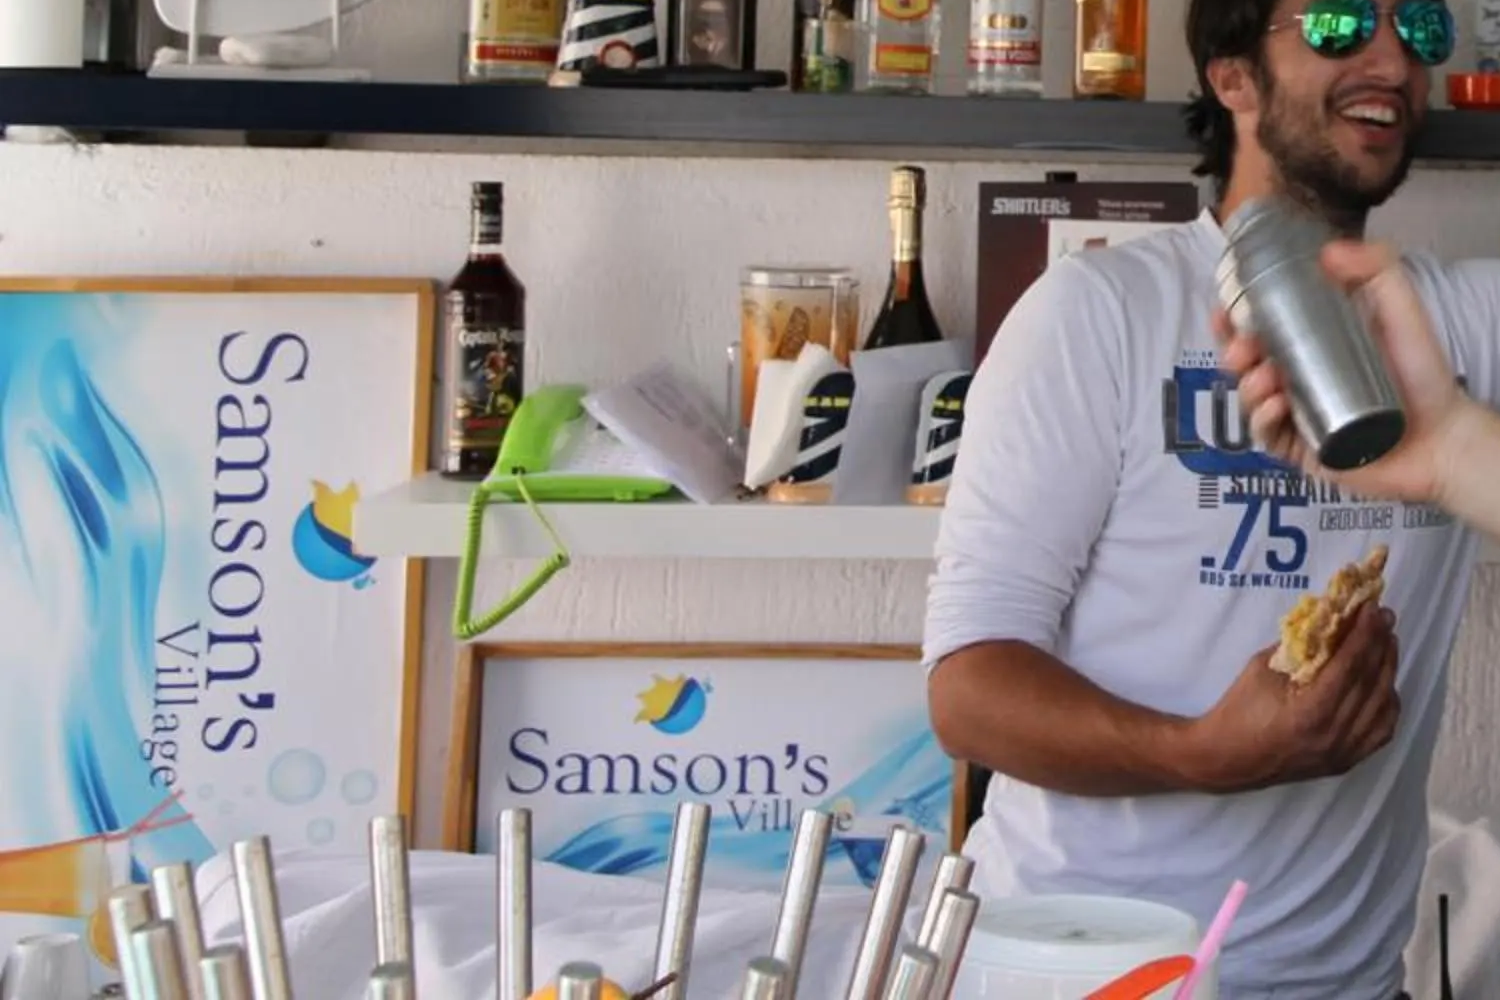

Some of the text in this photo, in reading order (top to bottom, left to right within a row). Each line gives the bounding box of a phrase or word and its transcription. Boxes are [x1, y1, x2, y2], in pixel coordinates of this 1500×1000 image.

[200, 330, 310, 754] Samson's
[141, 620, 200, 789] Village
[506, 727, 830, 796] Samson's
[727, 798, 854, 833] Ville
